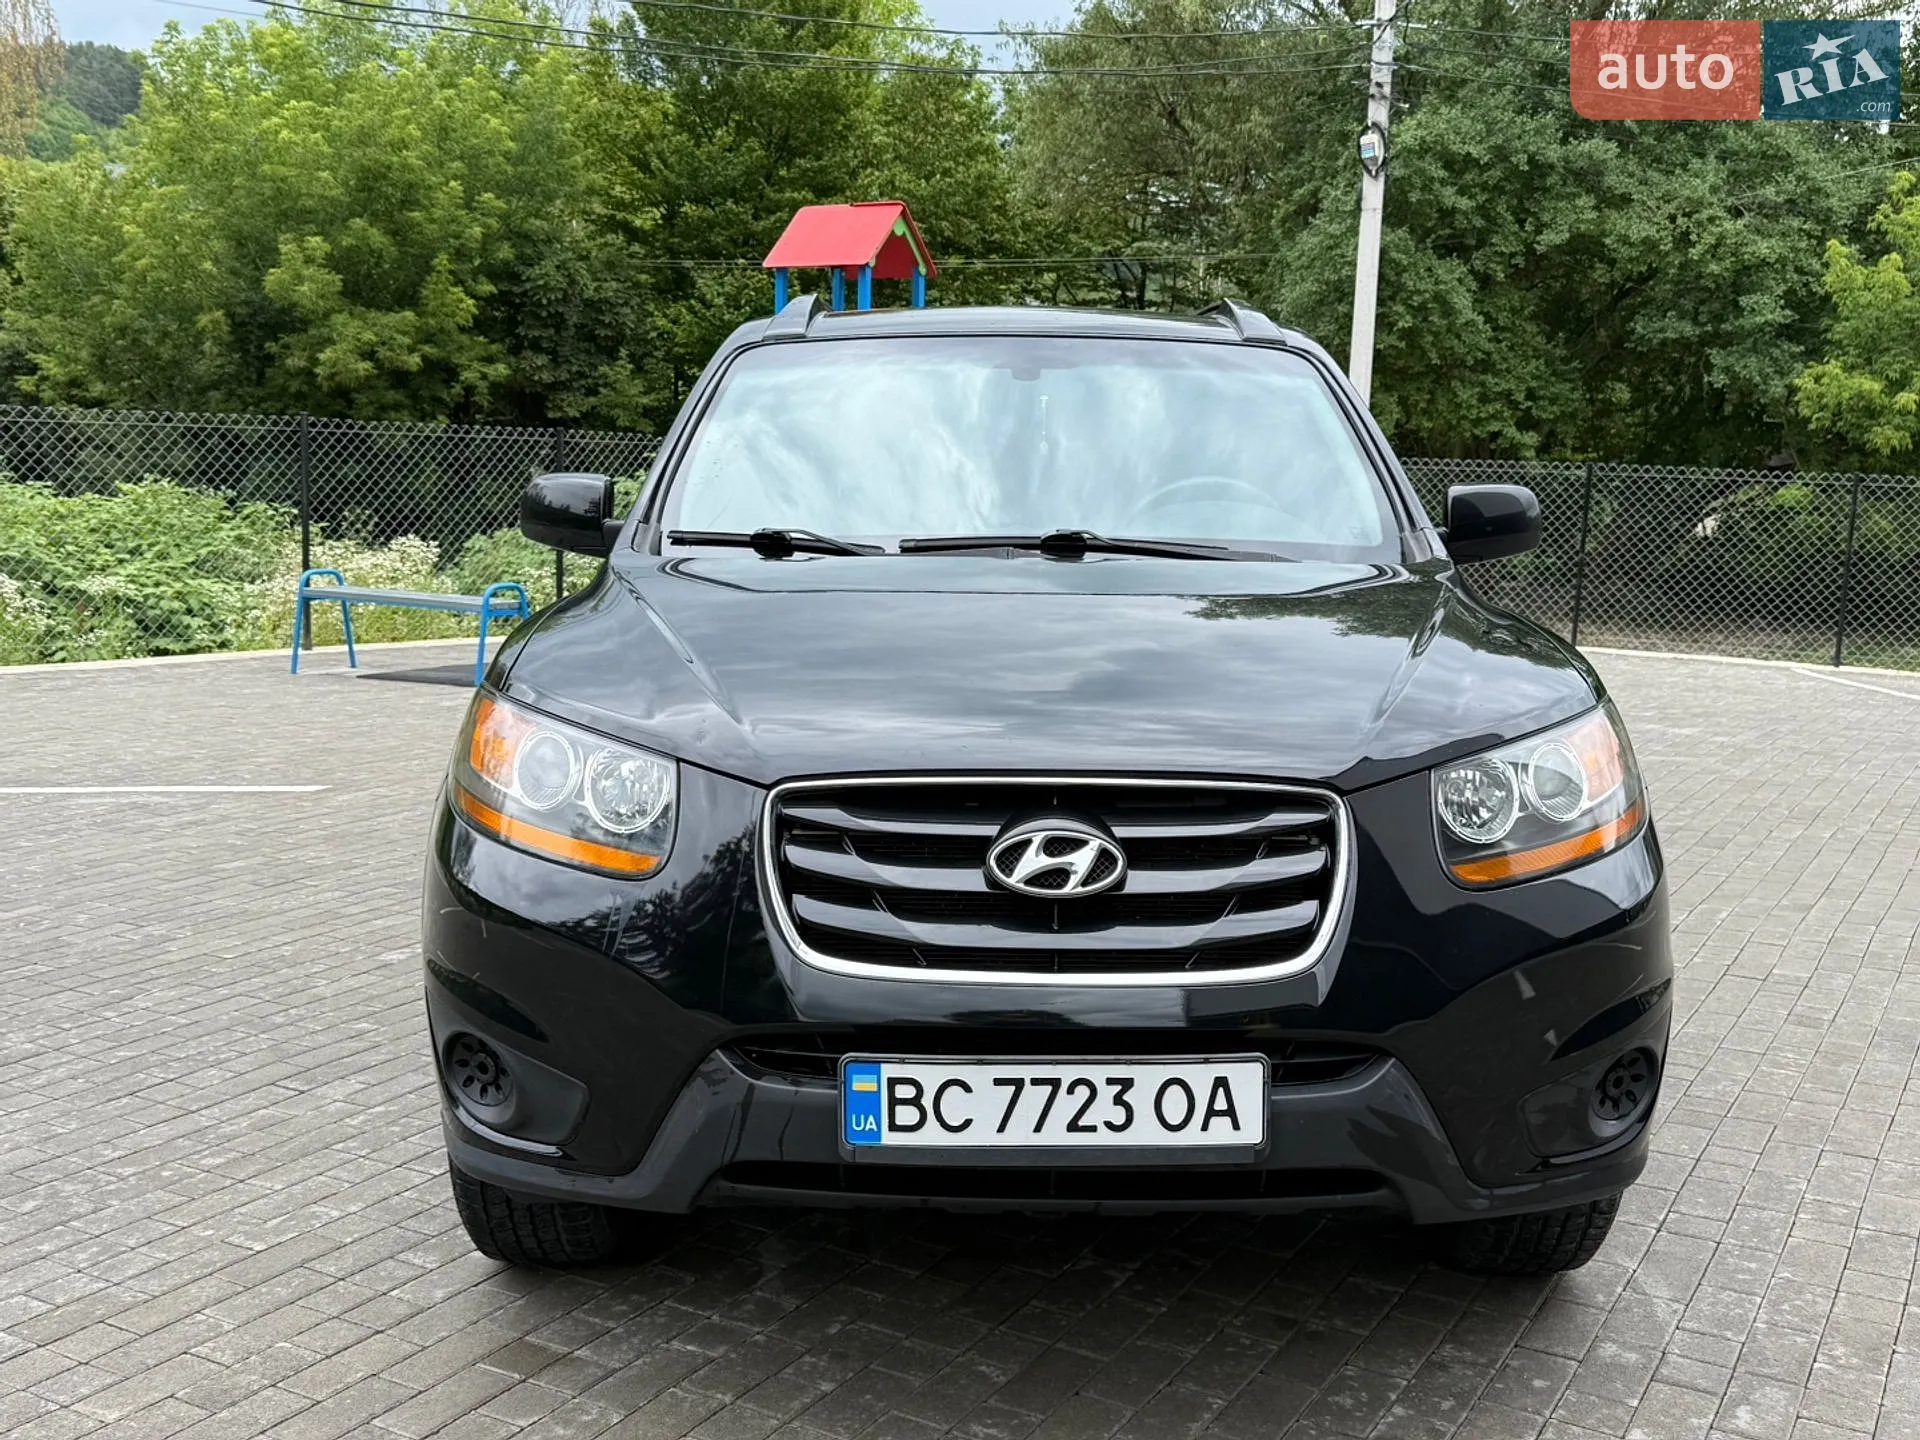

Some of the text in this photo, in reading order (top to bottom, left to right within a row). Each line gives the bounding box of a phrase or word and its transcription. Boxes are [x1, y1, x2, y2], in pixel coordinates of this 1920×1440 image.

[852, 1114, 878, 1132] UA
[887, 1076, 1241, 1133] BC 7723 OA
